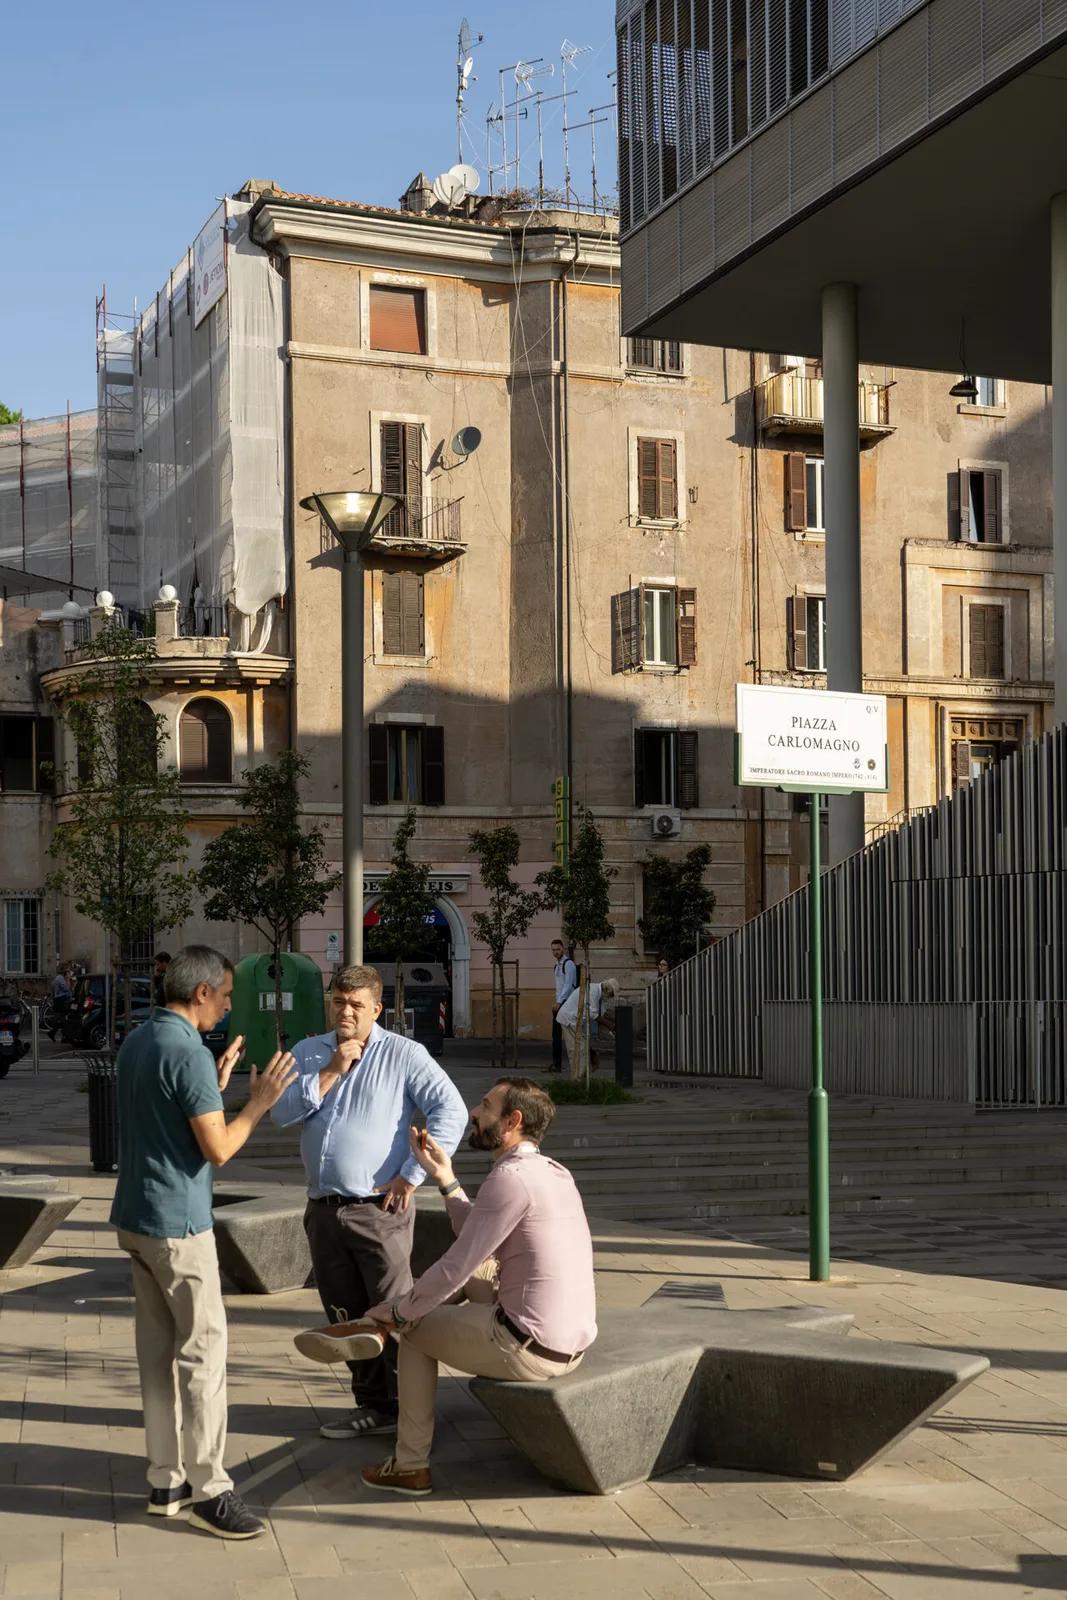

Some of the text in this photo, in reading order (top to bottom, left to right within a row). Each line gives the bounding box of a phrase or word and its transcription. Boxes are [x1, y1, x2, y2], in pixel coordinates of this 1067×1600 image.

[792, 716, 837, 731] PIAZZA
[768, 735, 860, 752] CARLOMAGNO
[750, 767, 785, 775] IMPERATORE
[787, 768, 805, 776] SACRO
[806, 769, 831, 777] ROMANO
